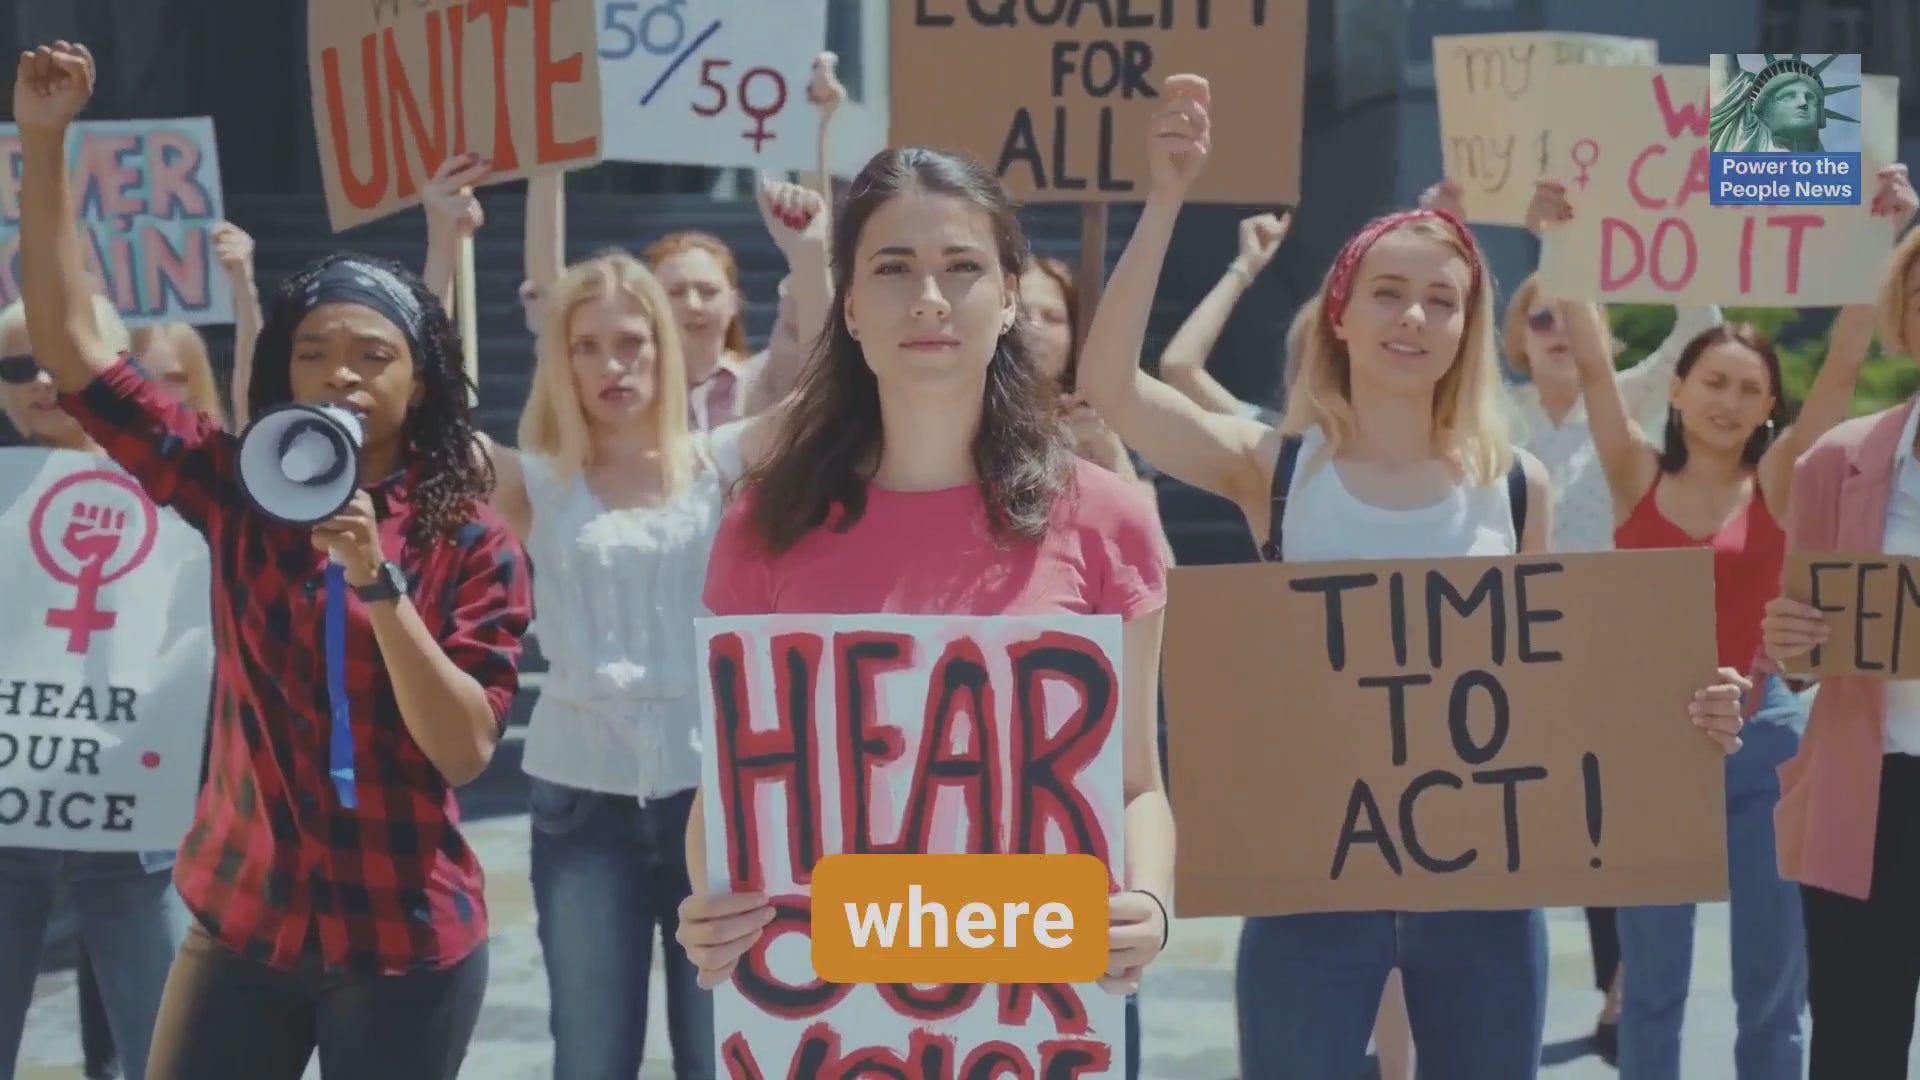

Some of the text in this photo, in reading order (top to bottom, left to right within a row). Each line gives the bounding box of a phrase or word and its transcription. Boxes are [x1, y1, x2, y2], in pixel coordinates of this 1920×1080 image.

[321, 0, 597, 209] UNITE
[1051, 40, 1160, 99] FOR
[1652, 73, 1713, 138] W
[996, 105, 1135, 192] ALL
[1627, 144, 1740, 211] CA
[1600, 214, 1825, 294] DO IT
[1288, 562, 1564, 672] TIME
[0, 680, 138, 723] HEAR
[1358, 669, 1511, 766] TO
[708, 630, 1121, 893] HEAR
